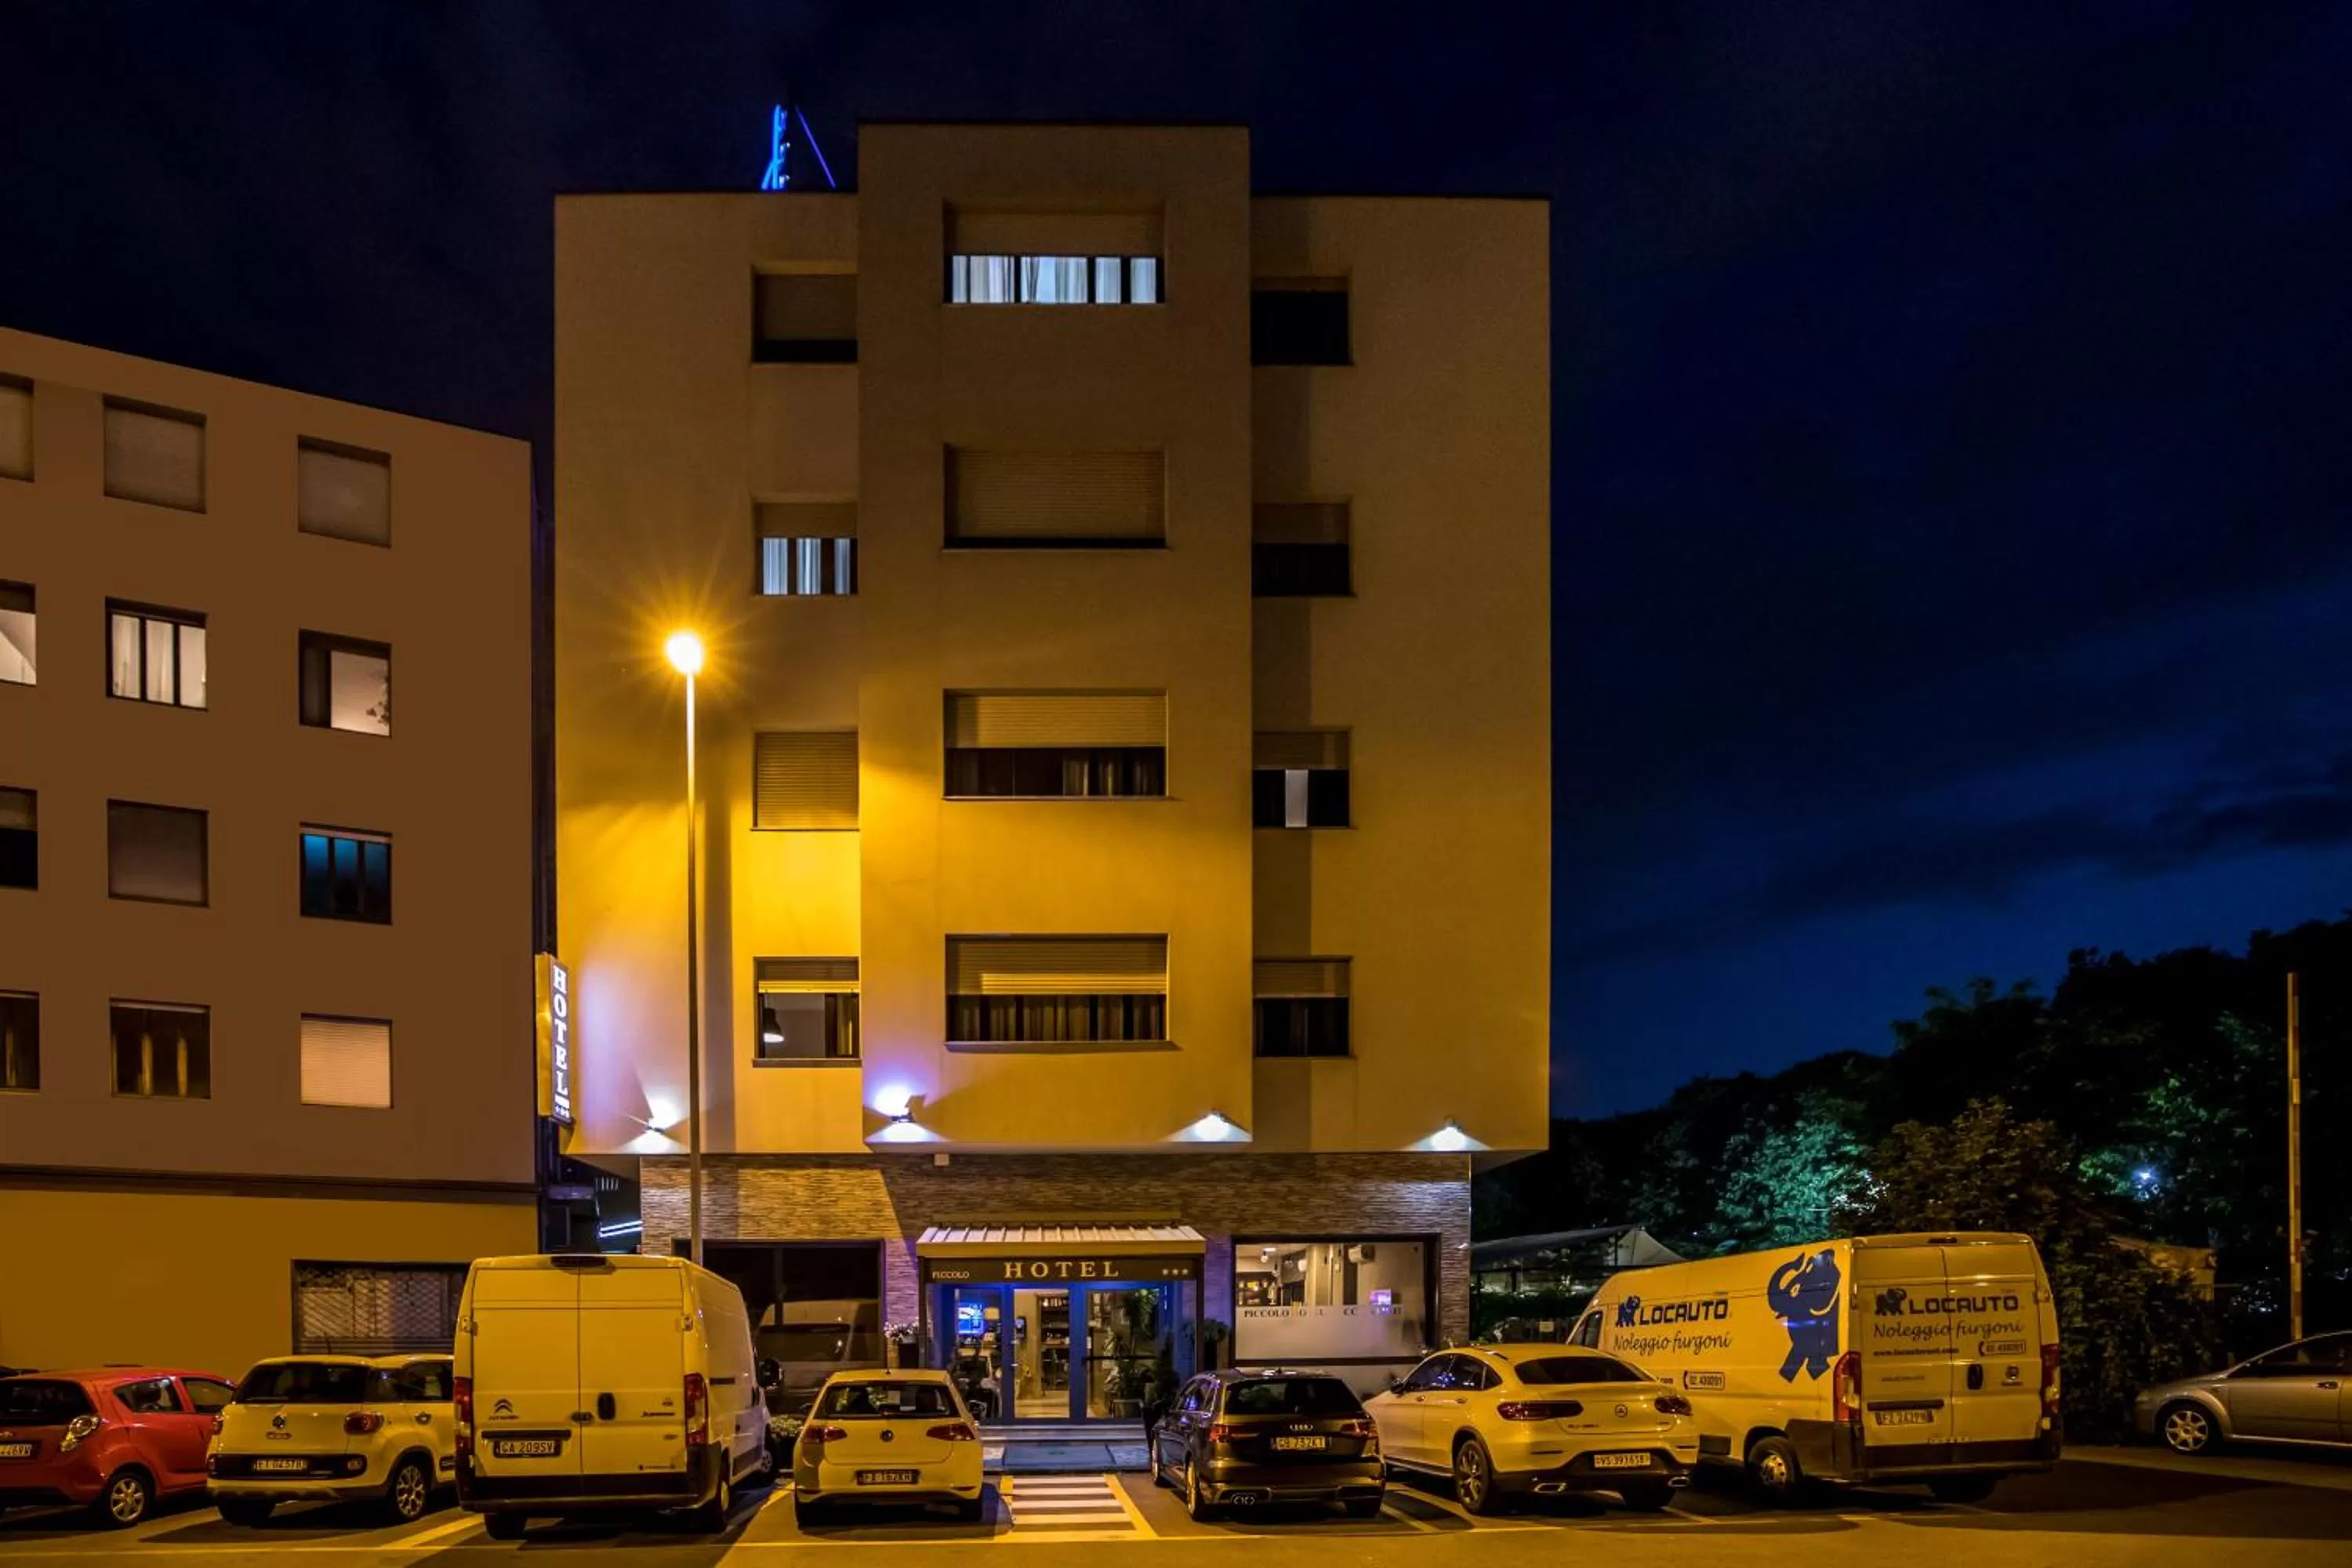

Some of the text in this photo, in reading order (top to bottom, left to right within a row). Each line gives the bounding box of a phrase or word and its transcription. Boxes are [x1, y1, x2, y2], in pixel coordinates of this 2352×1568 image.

[553, 965, 568, 1094] HOTEL
[932, 1261, 1120, 1279] PICCOLO HOTEL
[1243, 1308, 1290, 1318] PICCOLO
[1639, 1298, 1729, 1325] LOCAUTO
[1908, 1295, 2019, 1315] LOCAUTO
[1873, 1320, 2025, 1341] Noleggio furgoni
[1613, 1330, 1733, 1356] Noleggio furgoni
